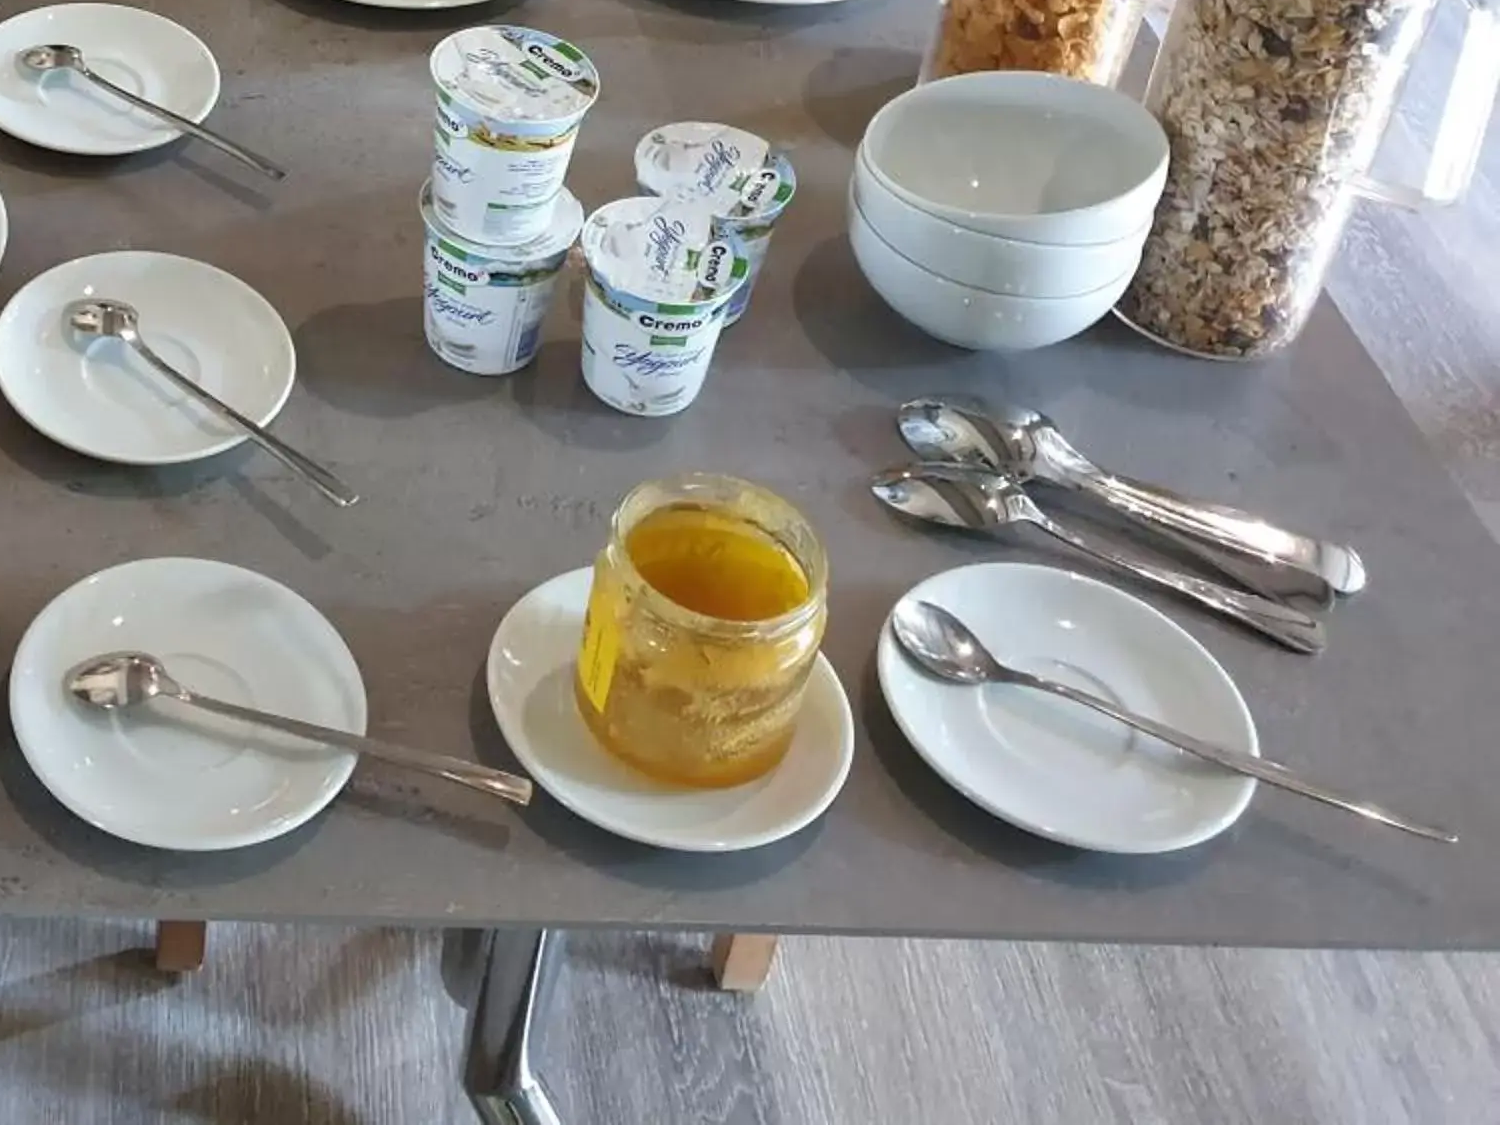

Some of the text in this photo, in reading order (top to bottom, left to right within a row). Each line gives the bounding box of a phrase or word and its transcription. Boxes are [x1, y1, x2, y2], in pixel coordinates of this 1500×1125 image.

[527, 43, 573, 78] Cremo
[747, 171, 776, 203] Cemo
[430, 245, 478, 282] Cremo
[704, 245, 727, 283] Cremo
[638, 314, 702, 332] Cremo
